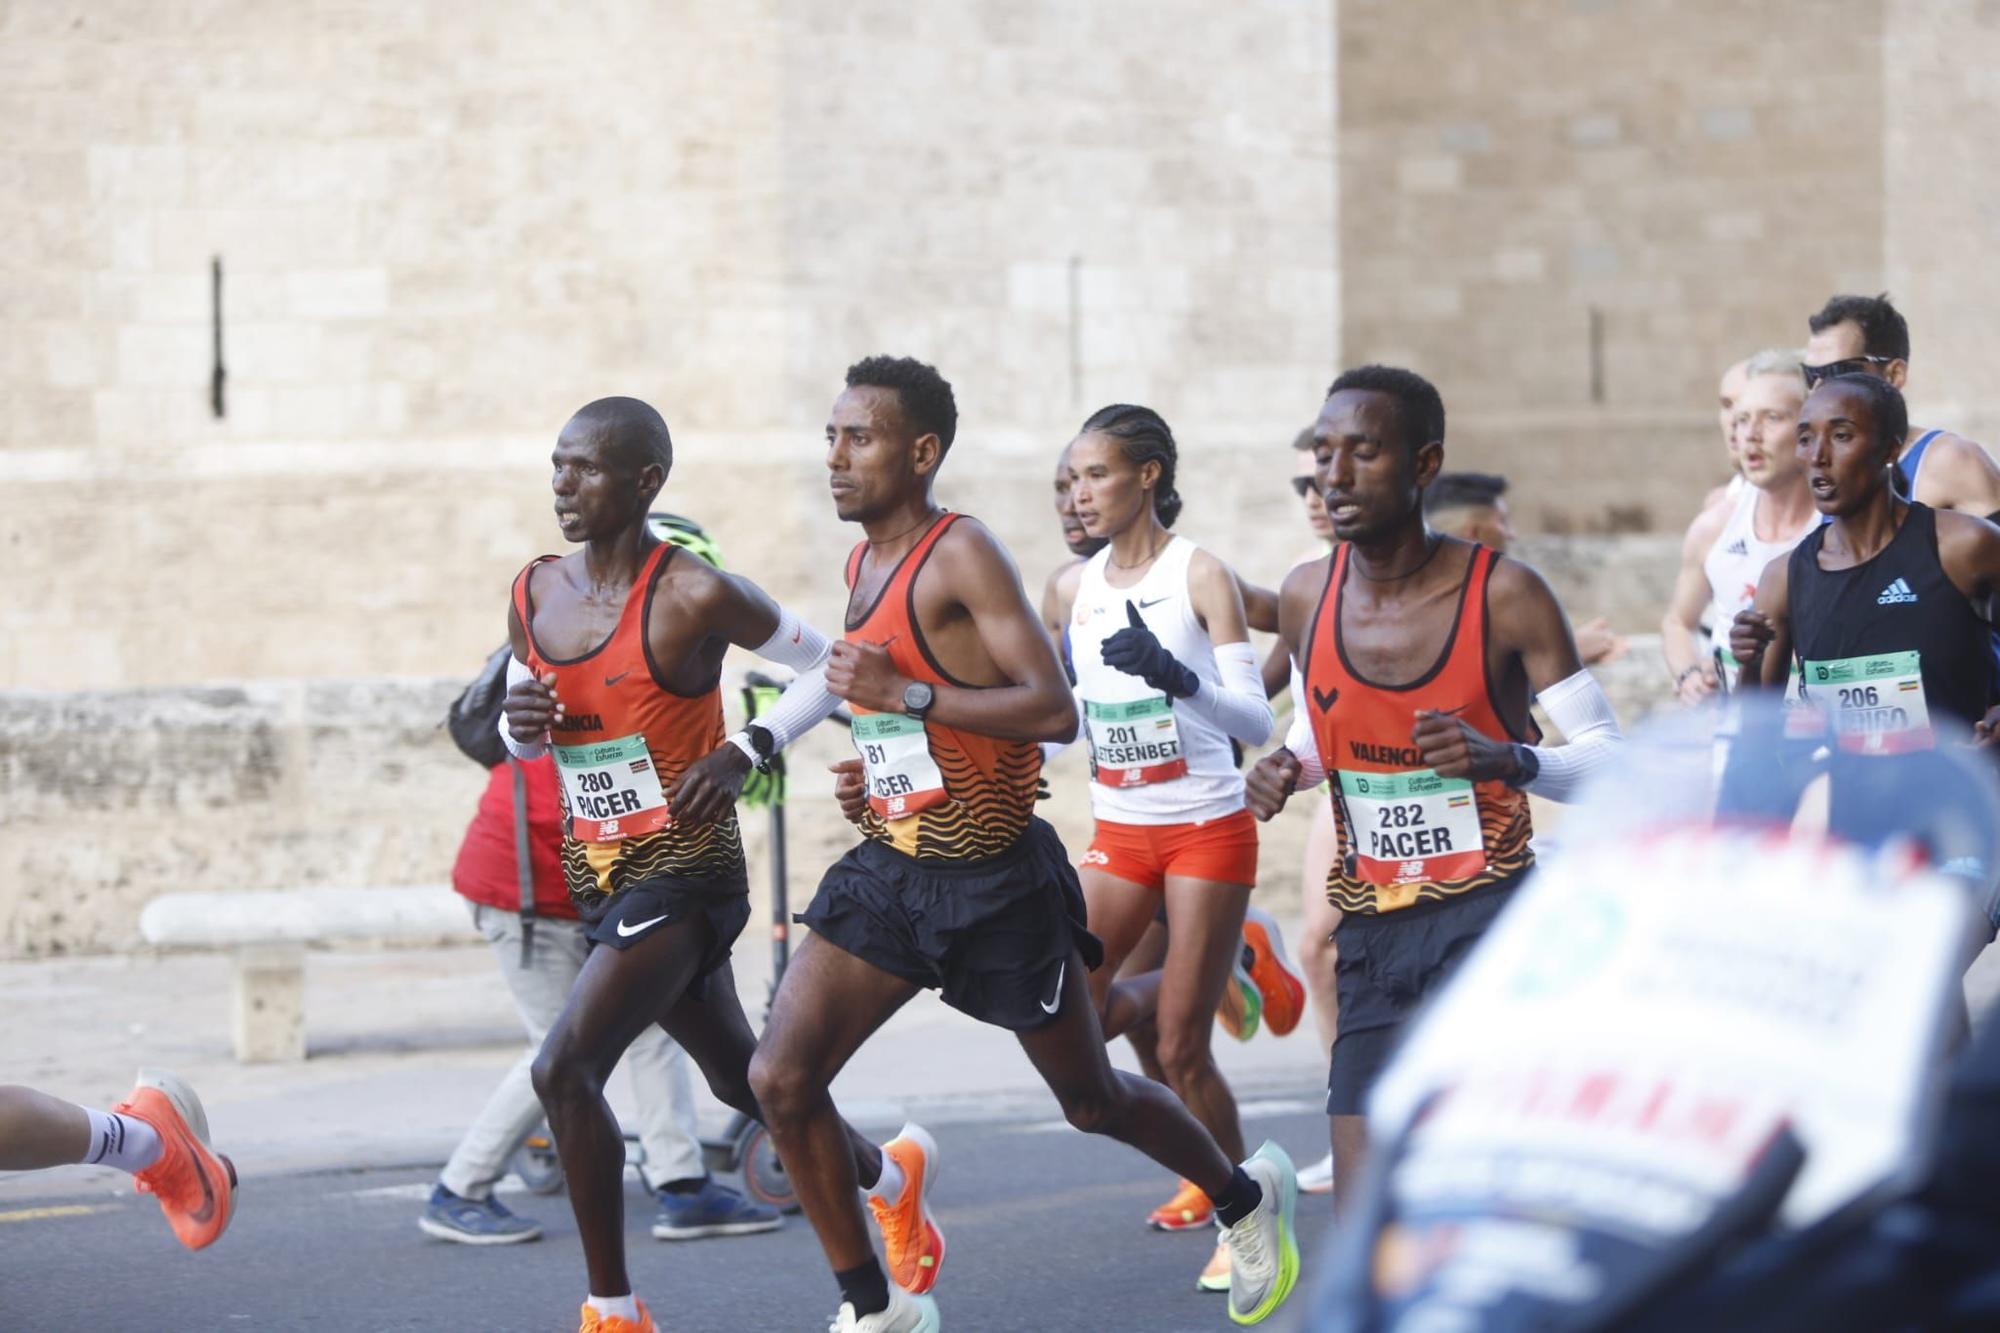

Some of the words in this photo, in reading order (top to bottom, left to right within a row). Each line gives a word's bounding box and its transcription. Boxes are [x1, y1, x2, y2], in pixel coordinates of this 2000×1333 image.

[1877, 594, 1918, 605] adidas
[1838, 686, 1879, 709] 206
[1106, 726, 1137, 744] 201
[865, 744, 886, 764] 81
[577, 771, 614, 793] 280
[873, 774, 914, 797] CER
[576, 789, 642, 819] PACER
[1378, 804, 1426, 828] 282
[1370, 826, 1453, 858] PACER
